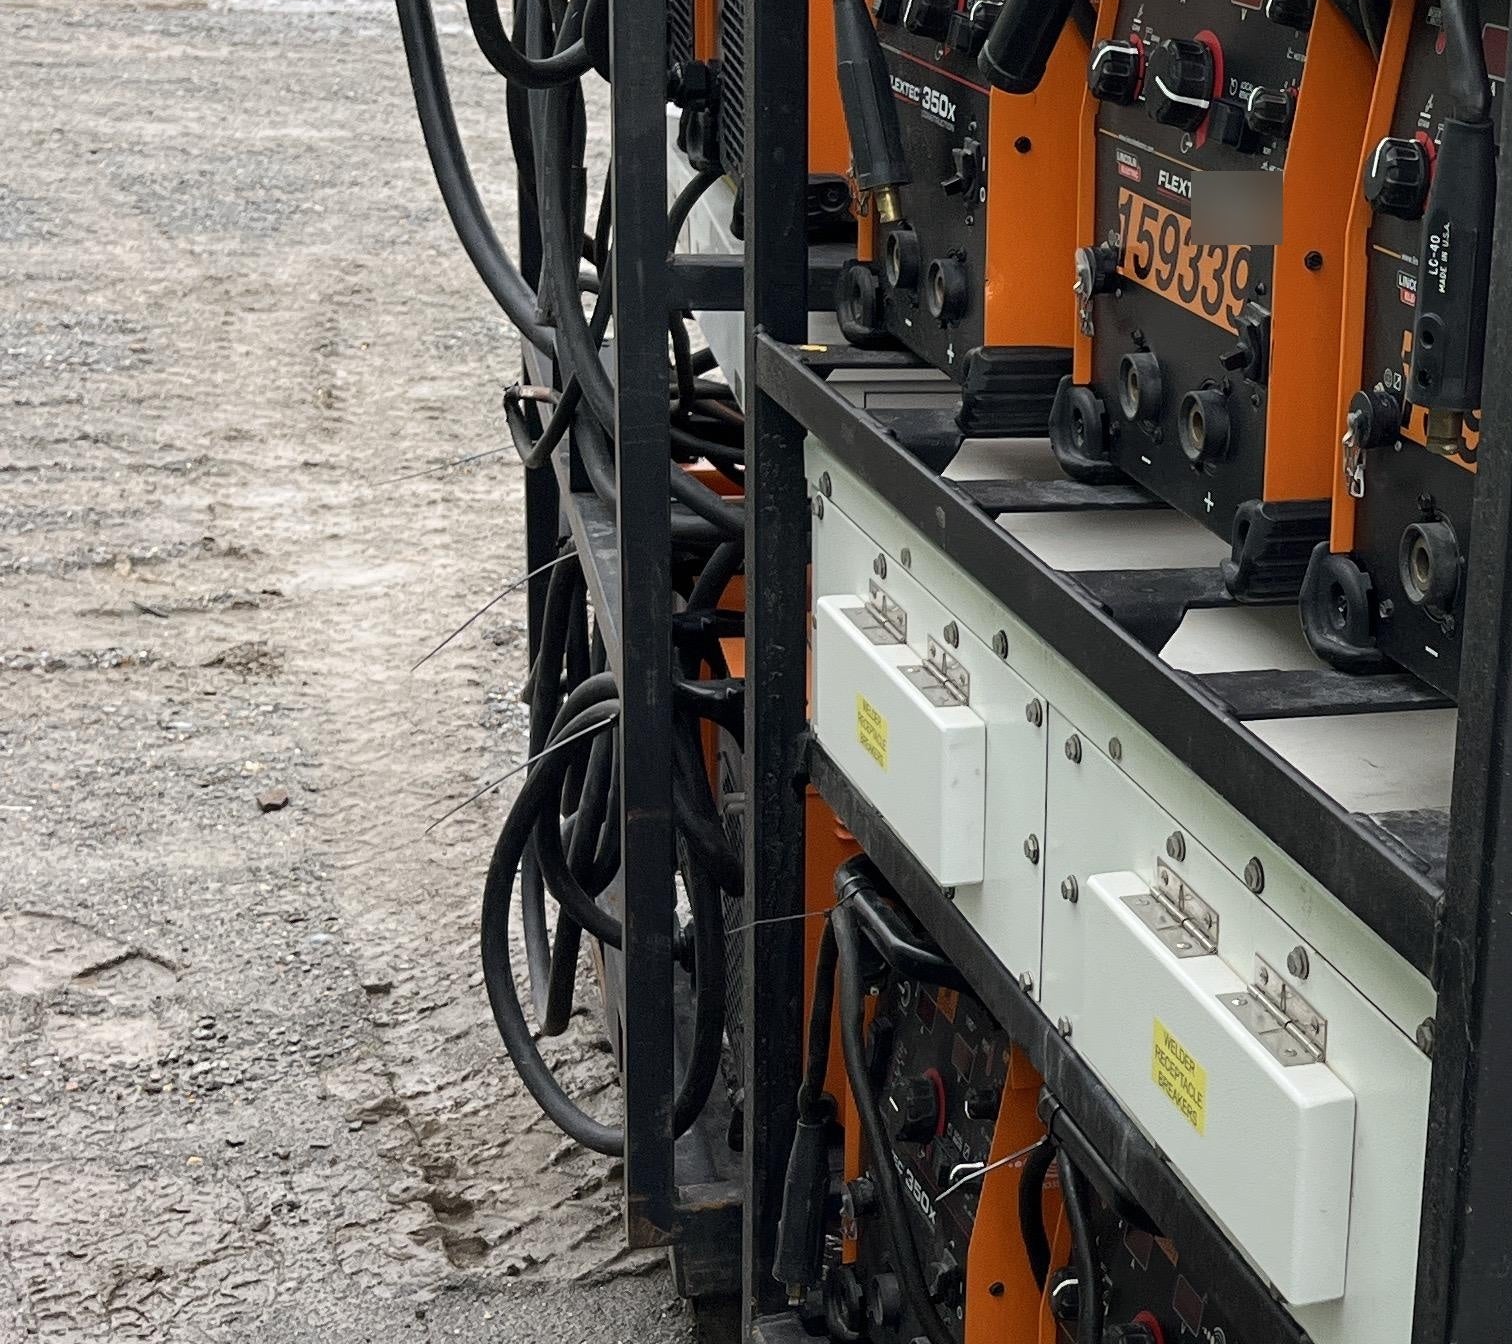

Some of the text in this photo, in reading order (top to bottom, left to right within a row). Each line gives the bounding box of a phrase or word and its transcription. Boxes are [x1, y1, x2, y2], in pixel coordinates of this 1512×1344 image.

[889, 73, 921, 102] LEXTEC
[1428, 234, 1441, 276] LC-40
[1441, 250, 1449, 263] IN
[1438, 266, 1448, 294] MADE
[1163, 1030, 1196, 1074] WELDER
[1155, 1043, 1203, 1110] RECEPTACLE
[1158, 1069, 1198, 1127] BREAKERS
